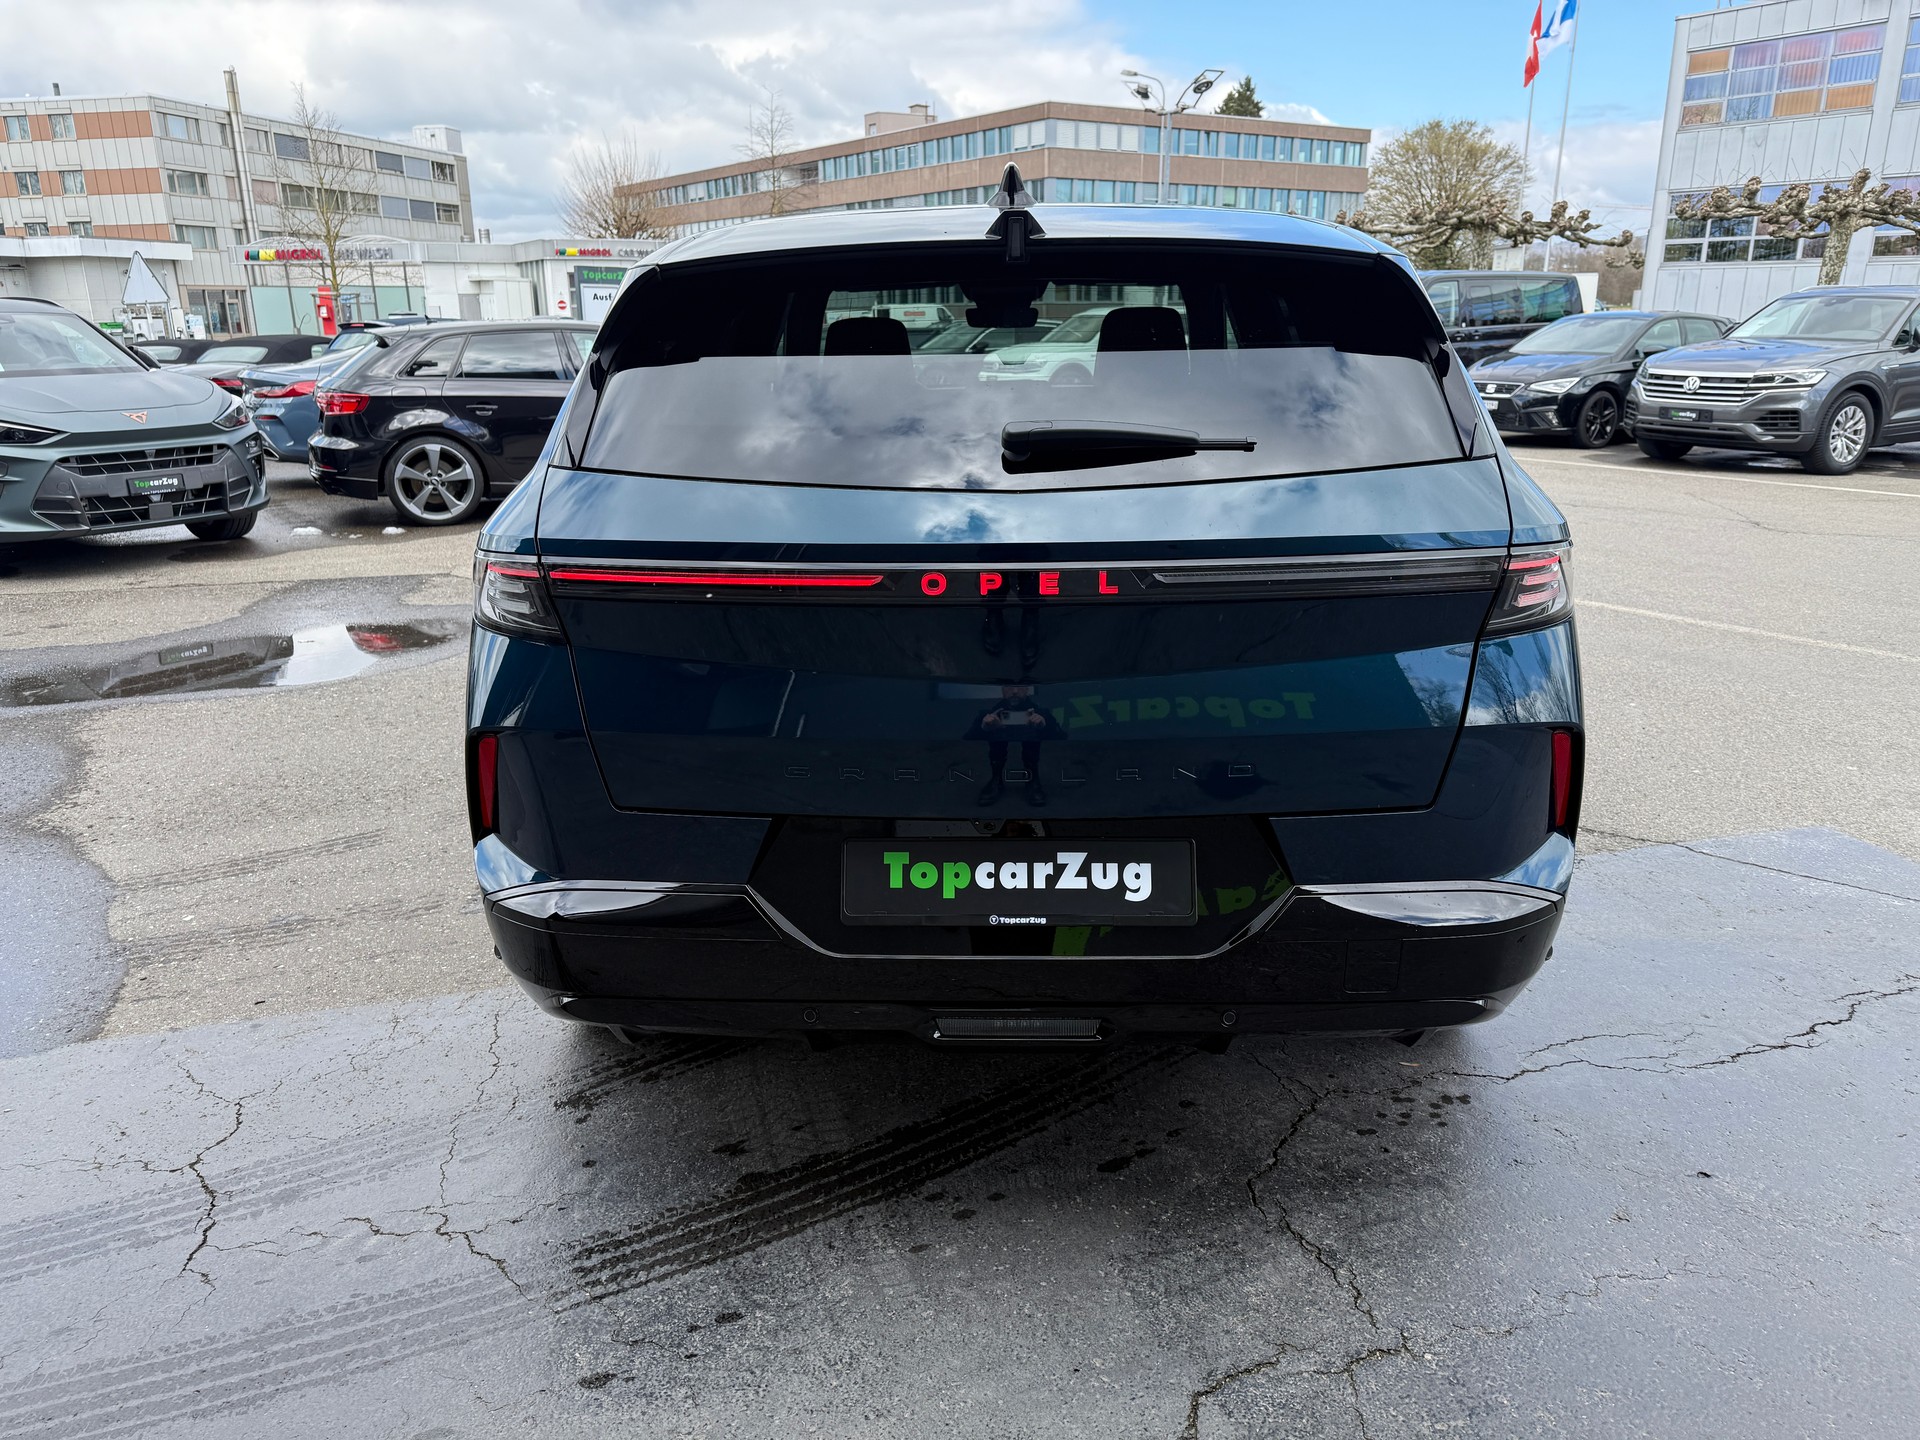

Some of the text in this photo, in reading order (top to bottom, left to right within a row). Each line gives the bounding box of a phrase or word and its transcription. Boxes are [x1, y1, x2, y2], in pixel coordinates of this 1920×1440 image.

[275, 249, 323, 260] MIGROL
[579, 248, 612, 257] MIGROL
[618, 249, 635, 257] CAR
[583, 271, 624, 281] TopcarZ
[593, 293, 612, 301] Ausf
[134, 478, 178, 488] TopcarZug
[921, 570, 1118, 596] OPEL
[784, 763, 1256, 782] GRANDLAND
[883, 851, 1153, 902] TopcarZug
[1000, 917, 1047, 925] TopcarZug
